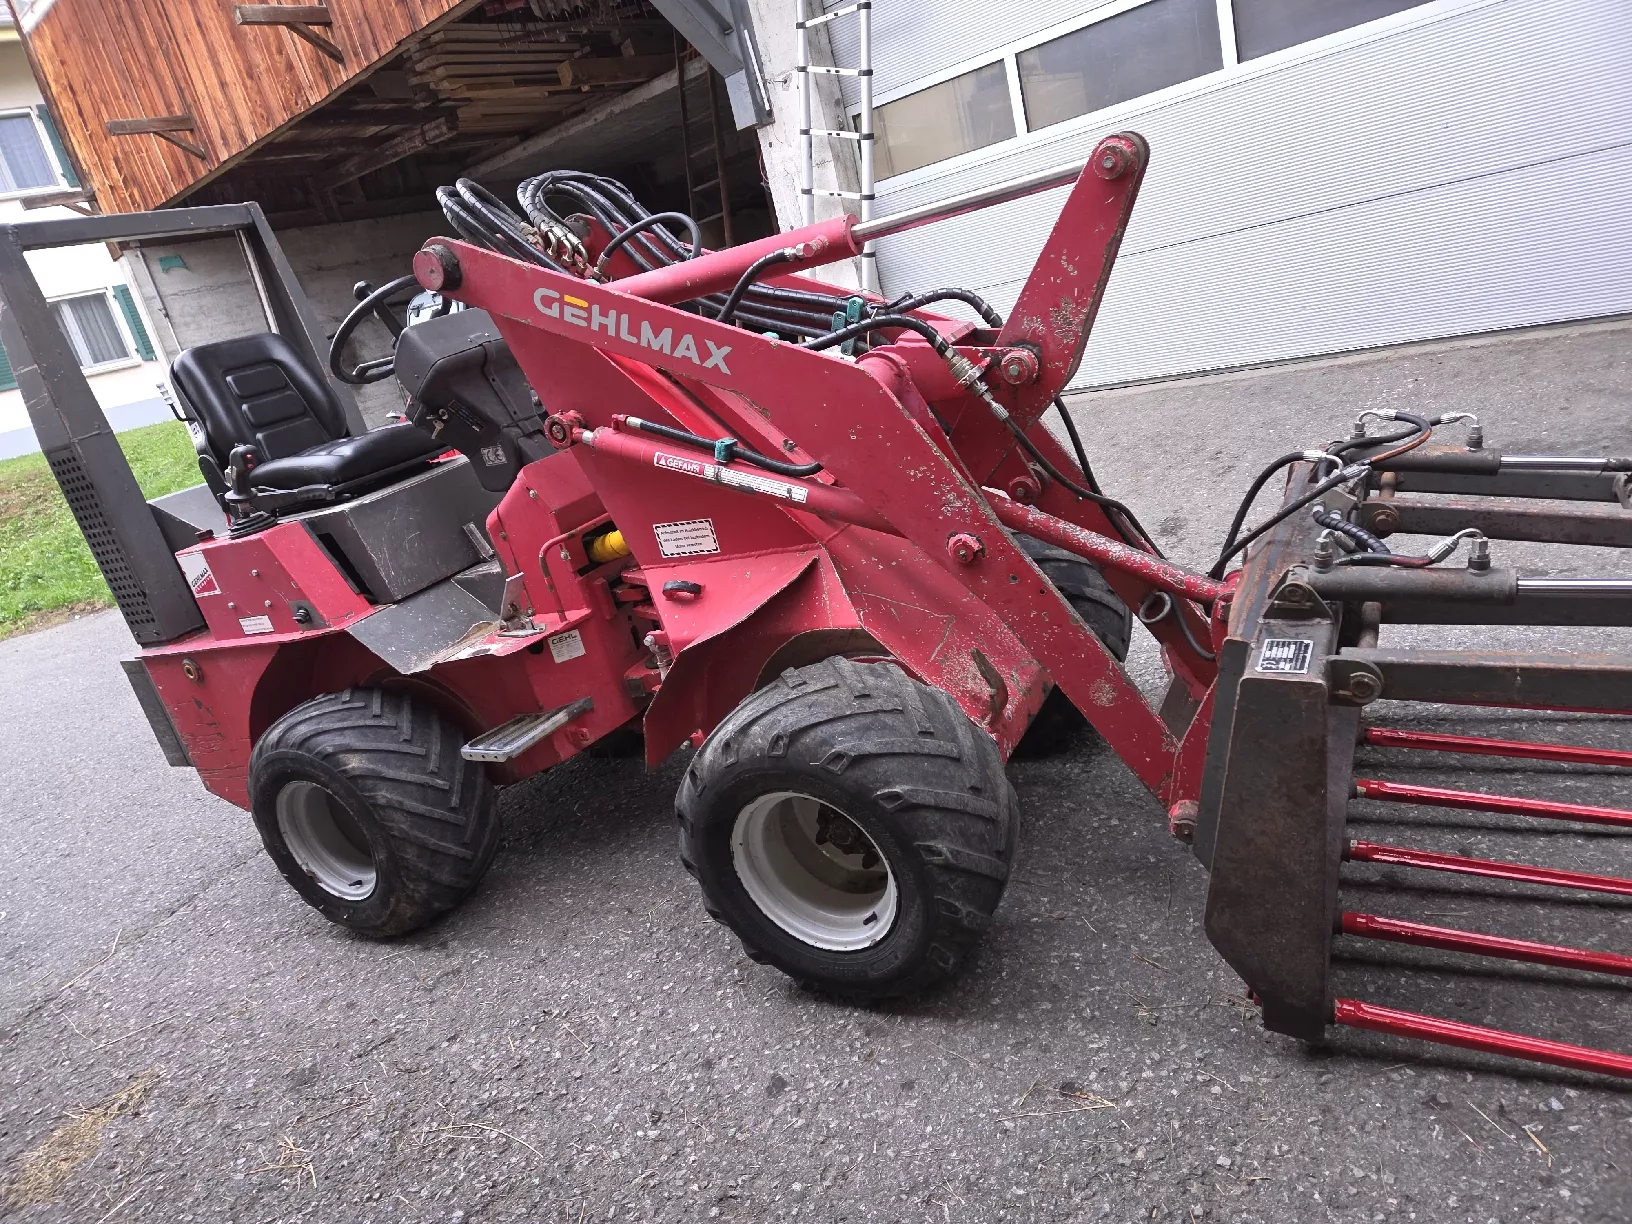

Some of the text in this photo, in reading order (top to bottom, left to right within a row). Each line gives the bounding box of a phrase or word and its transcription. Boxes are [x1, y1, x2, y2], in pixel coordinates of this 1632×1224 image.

[533, 287, 733, 376] GEHLMAX
[666, 457, 700, 473] GEFAHR
[191, 567, 209, 588] GEHLMAX
[551, 633, 578, 645] GEHL
